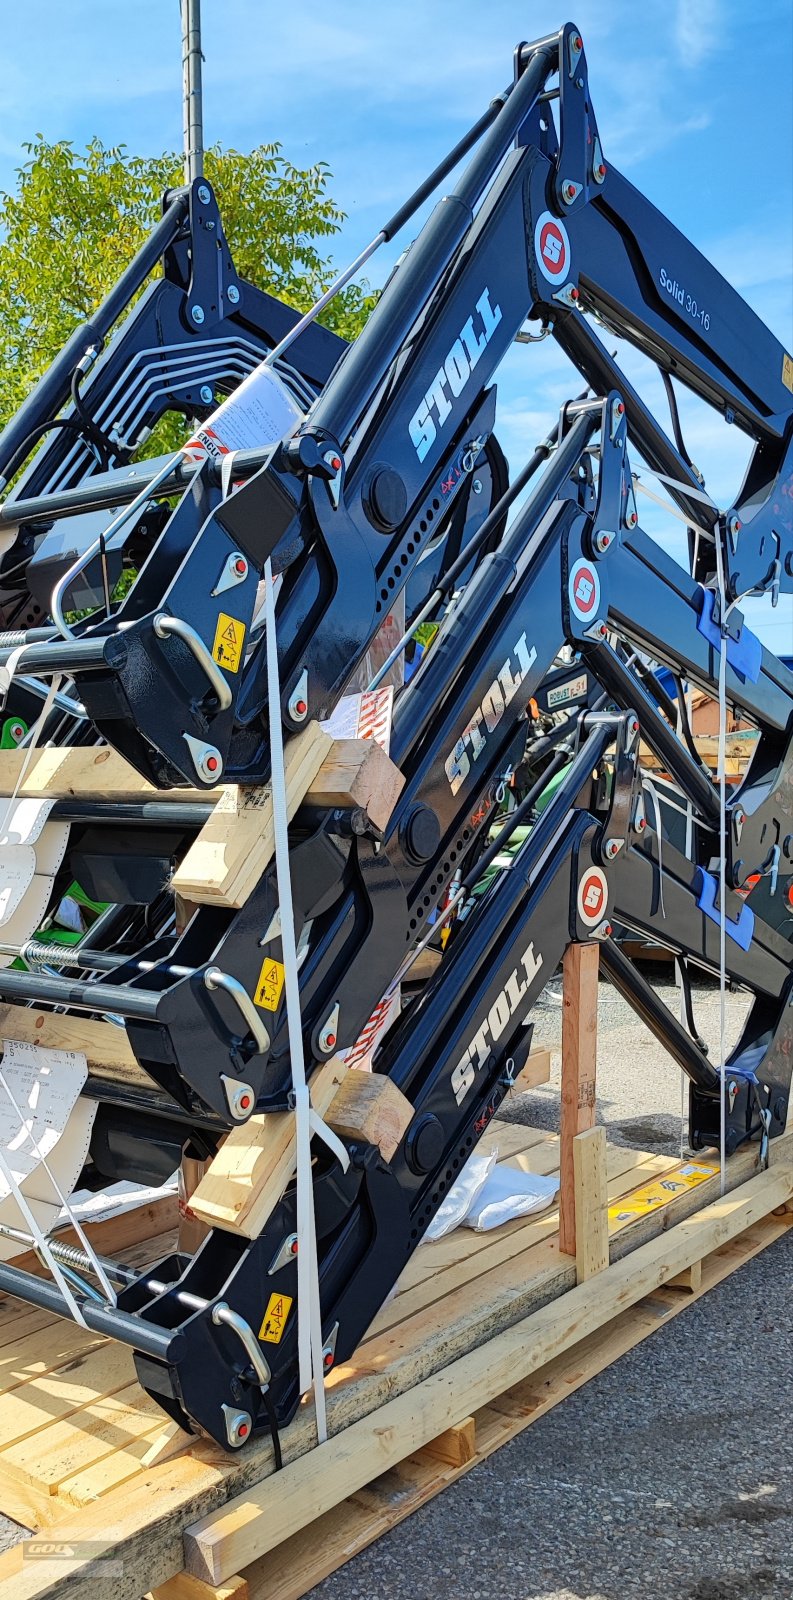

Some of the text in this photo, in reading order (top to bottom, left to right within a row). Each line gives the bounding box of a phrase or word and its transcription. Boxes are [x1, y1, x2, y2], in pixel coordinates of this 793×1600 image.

[542, 233, 563, 264] S
[660, 268, 711, 331] Solid 30-16
[408, 286, 503, 464] STOLL
[444, 631, 538, 797] STOLL
[450, 941, 544, 1108] STOLL
